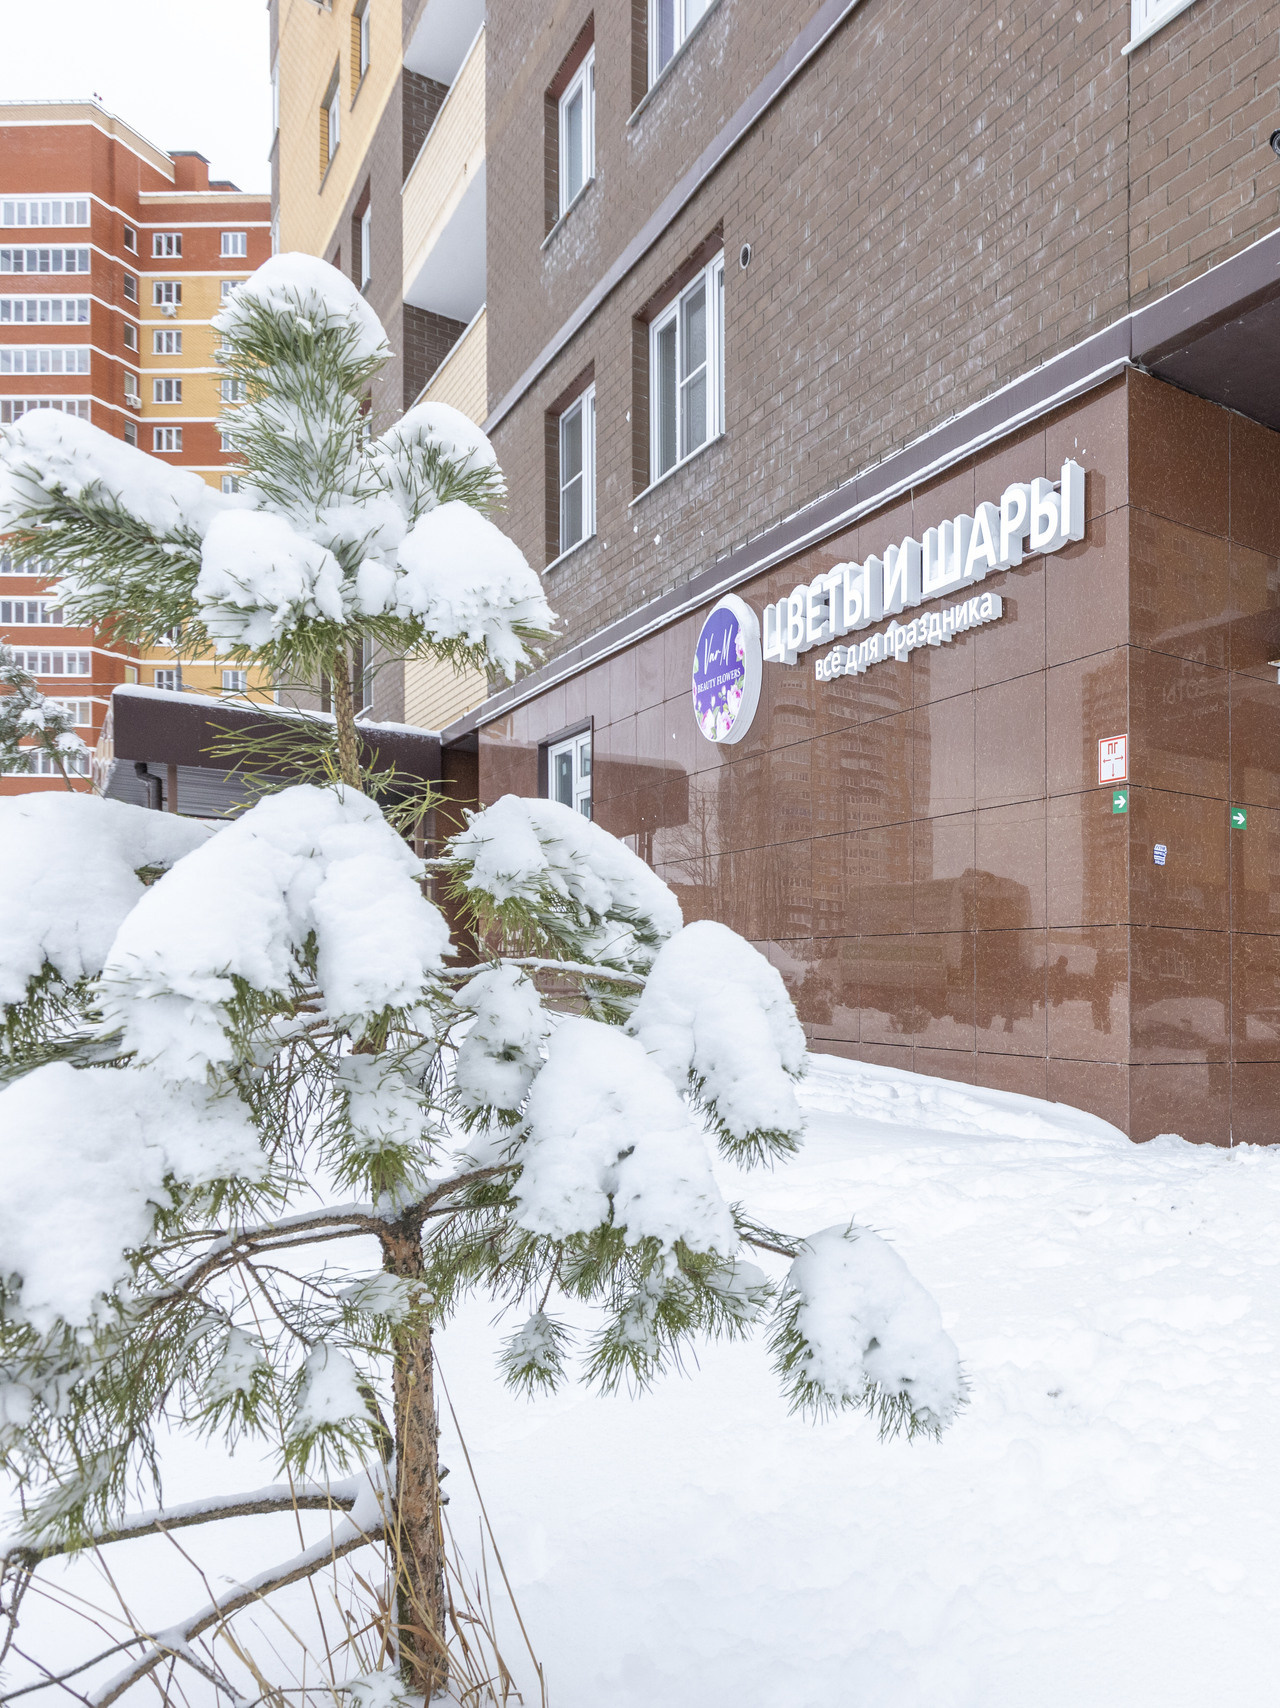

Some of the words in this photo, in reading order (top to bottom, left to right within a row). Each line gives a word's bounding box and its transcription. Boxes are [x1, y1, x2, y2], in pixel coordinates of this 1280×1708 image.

[763, 555, 881, 665] ЦВЕТЫ
[883, 537, 920, 615] И
[922, 460, 1085, 598] ШАРЫ
[815, 645, 842, 682] всё
[845, 634, 881, 675] для
[883, 592, 1001, 662] праздника
[697, 678, 716, 693] BEAUTY
[716, 667, 741, 685] FLOWERS
[1107, 741, 1118, 755] ПГ
